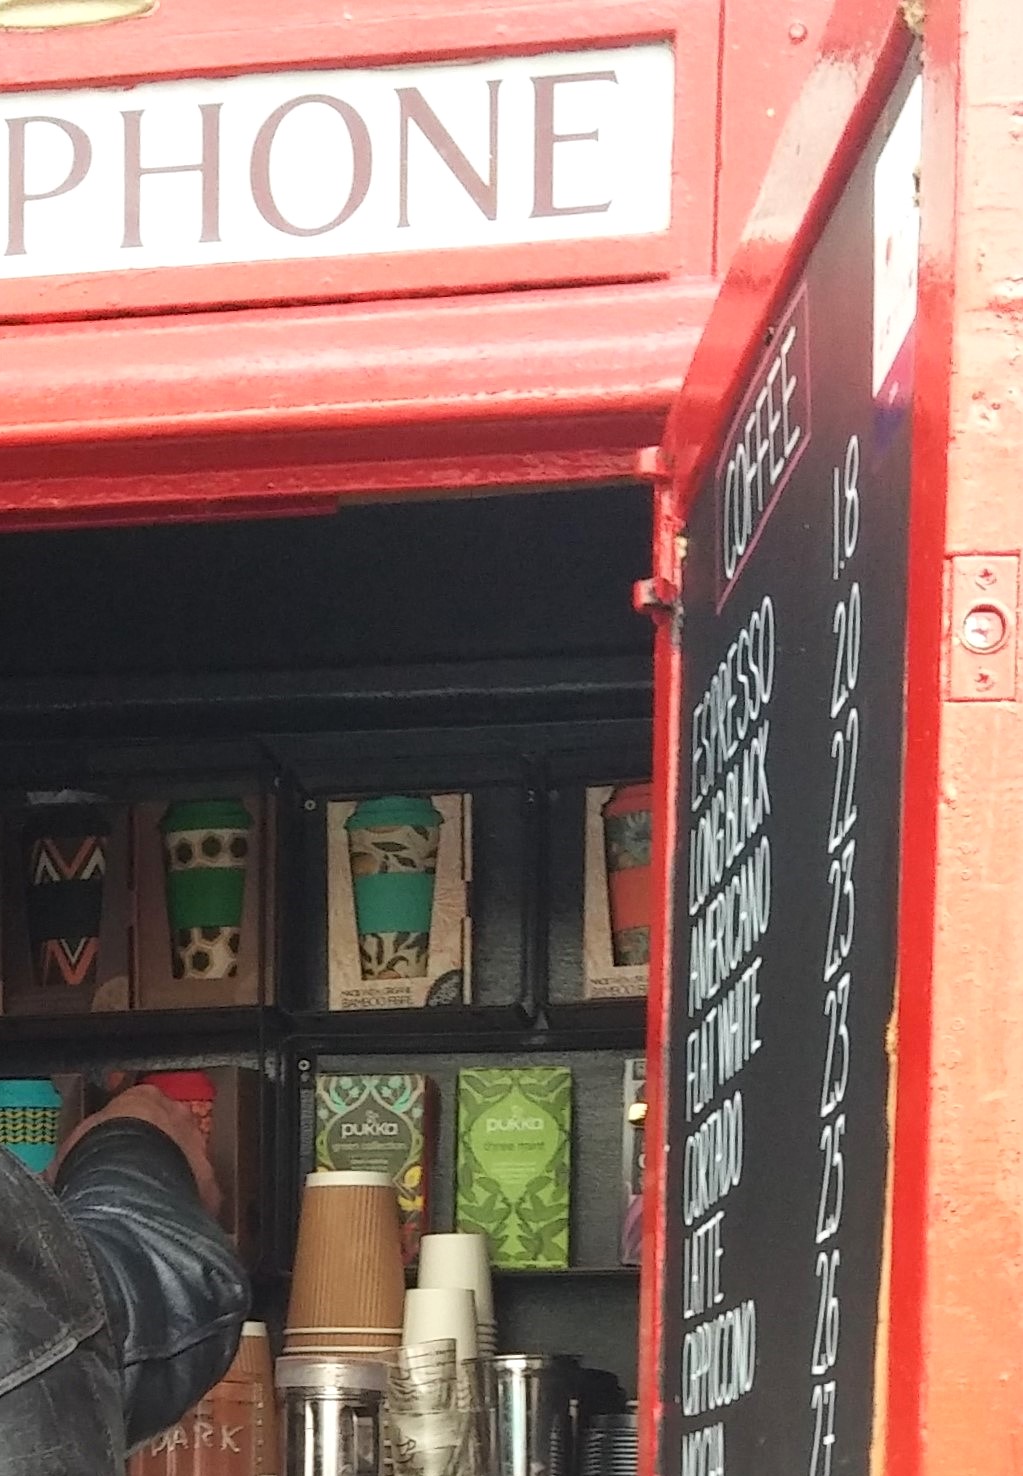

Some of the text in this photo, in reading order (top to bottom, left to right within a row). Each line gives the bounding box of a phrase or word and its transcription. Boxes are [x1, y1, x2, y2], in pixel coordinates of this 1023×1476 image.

[725, 325, 801, 579] COFFEE
[691, 596, 774, 812] ESPRESSO
[689, 787, 725, 916] LONG
[725, 719, 772, 868] BLACK
[689, 836, 772, 1018] AMERICANO
[686, 1006, 717, 1122] FLAT
[718, 956, 762, 1085] WHITE
[341, 1122, 398, 1139] pukka
[486, 1117, 544, 1133] pukka
[684, 1090, 743, 1226] CORTADO
[684, 1210, 725, 1319] LATTE
